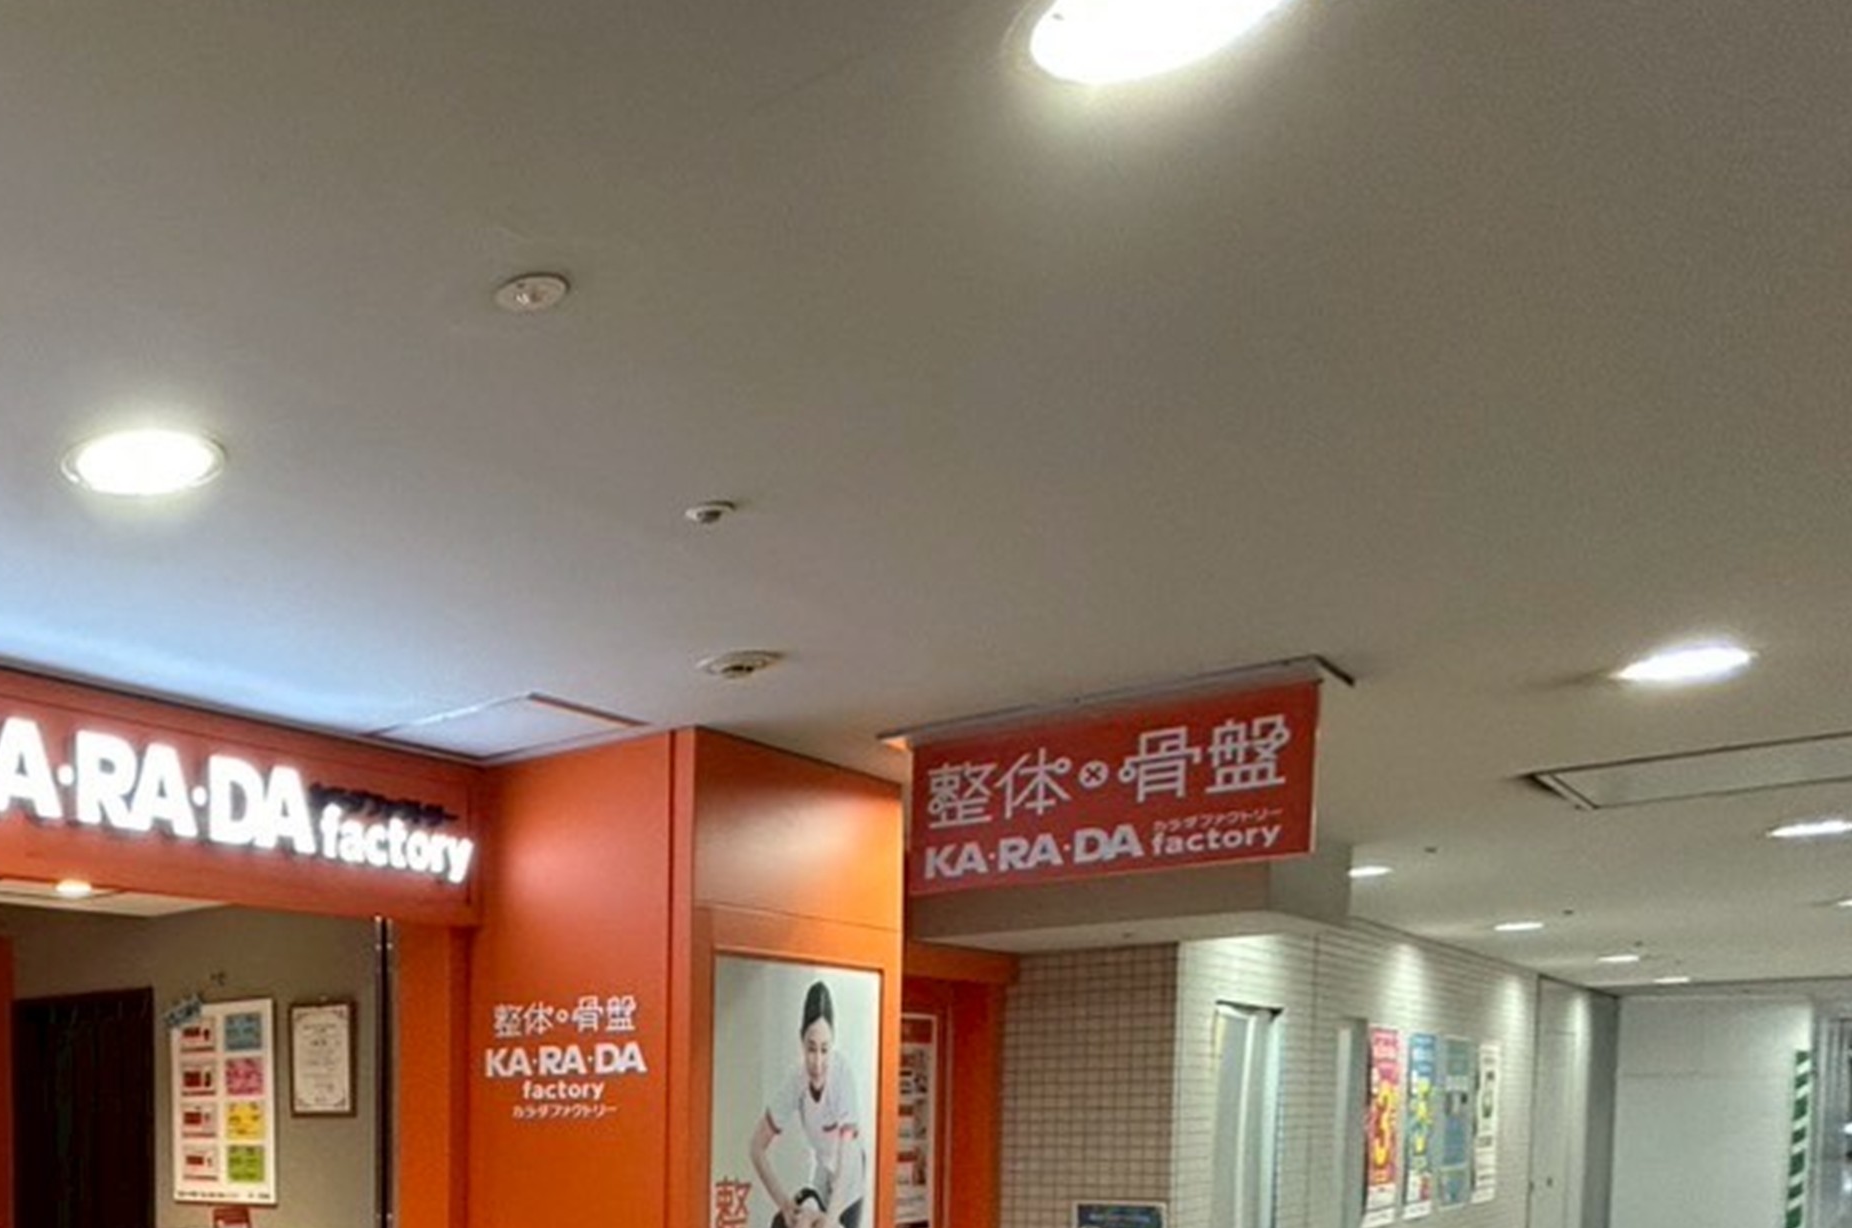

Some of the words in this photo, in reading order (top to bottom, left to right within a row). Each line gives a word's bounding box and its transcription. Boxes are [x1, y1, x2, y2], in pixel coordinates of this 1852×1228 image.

[319, 803, 475, 885] factory
[1152, 825, 1282, 857] factory
[522, 1080, 606, 1100] factory
